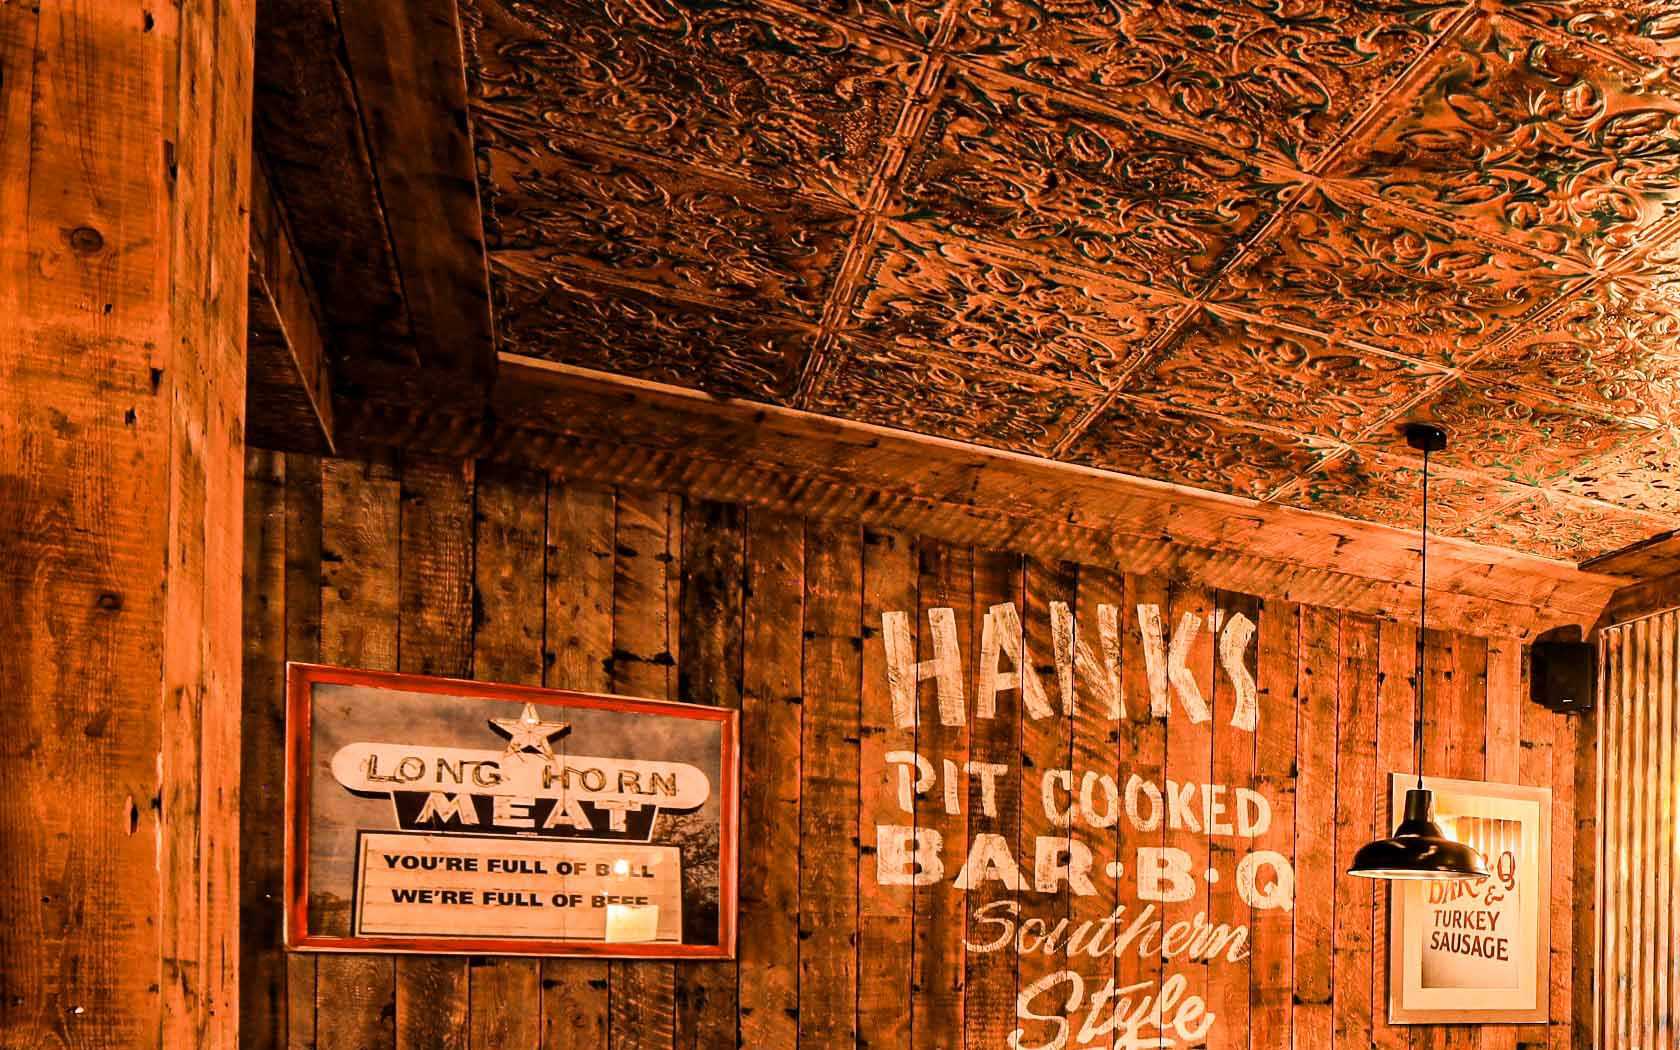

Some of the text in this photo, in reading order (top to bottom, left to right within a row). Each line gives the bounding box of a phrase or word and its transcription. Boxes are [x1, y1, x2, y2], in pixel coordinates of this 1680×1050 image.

[882, 600, 1260, 732] HANK'S
[366, 753, 679, 798] LONG HORN
[884, 750, 1273, 838] PIT COOKED
[415, 790, 643, 833] MEAT
[383, 854, 655, 879] YOU'RE FULL OF BLL
[391, 888, 475, 905] WE'RE
[482, 891, 544, 907] FULL
[551, 894, 583, 908] OF
[962, 900, 1251, 964] Southern
[1434, 909, 1501, 931] TURKEY
[1430, 930, 1509, 962] SAUSAGE
